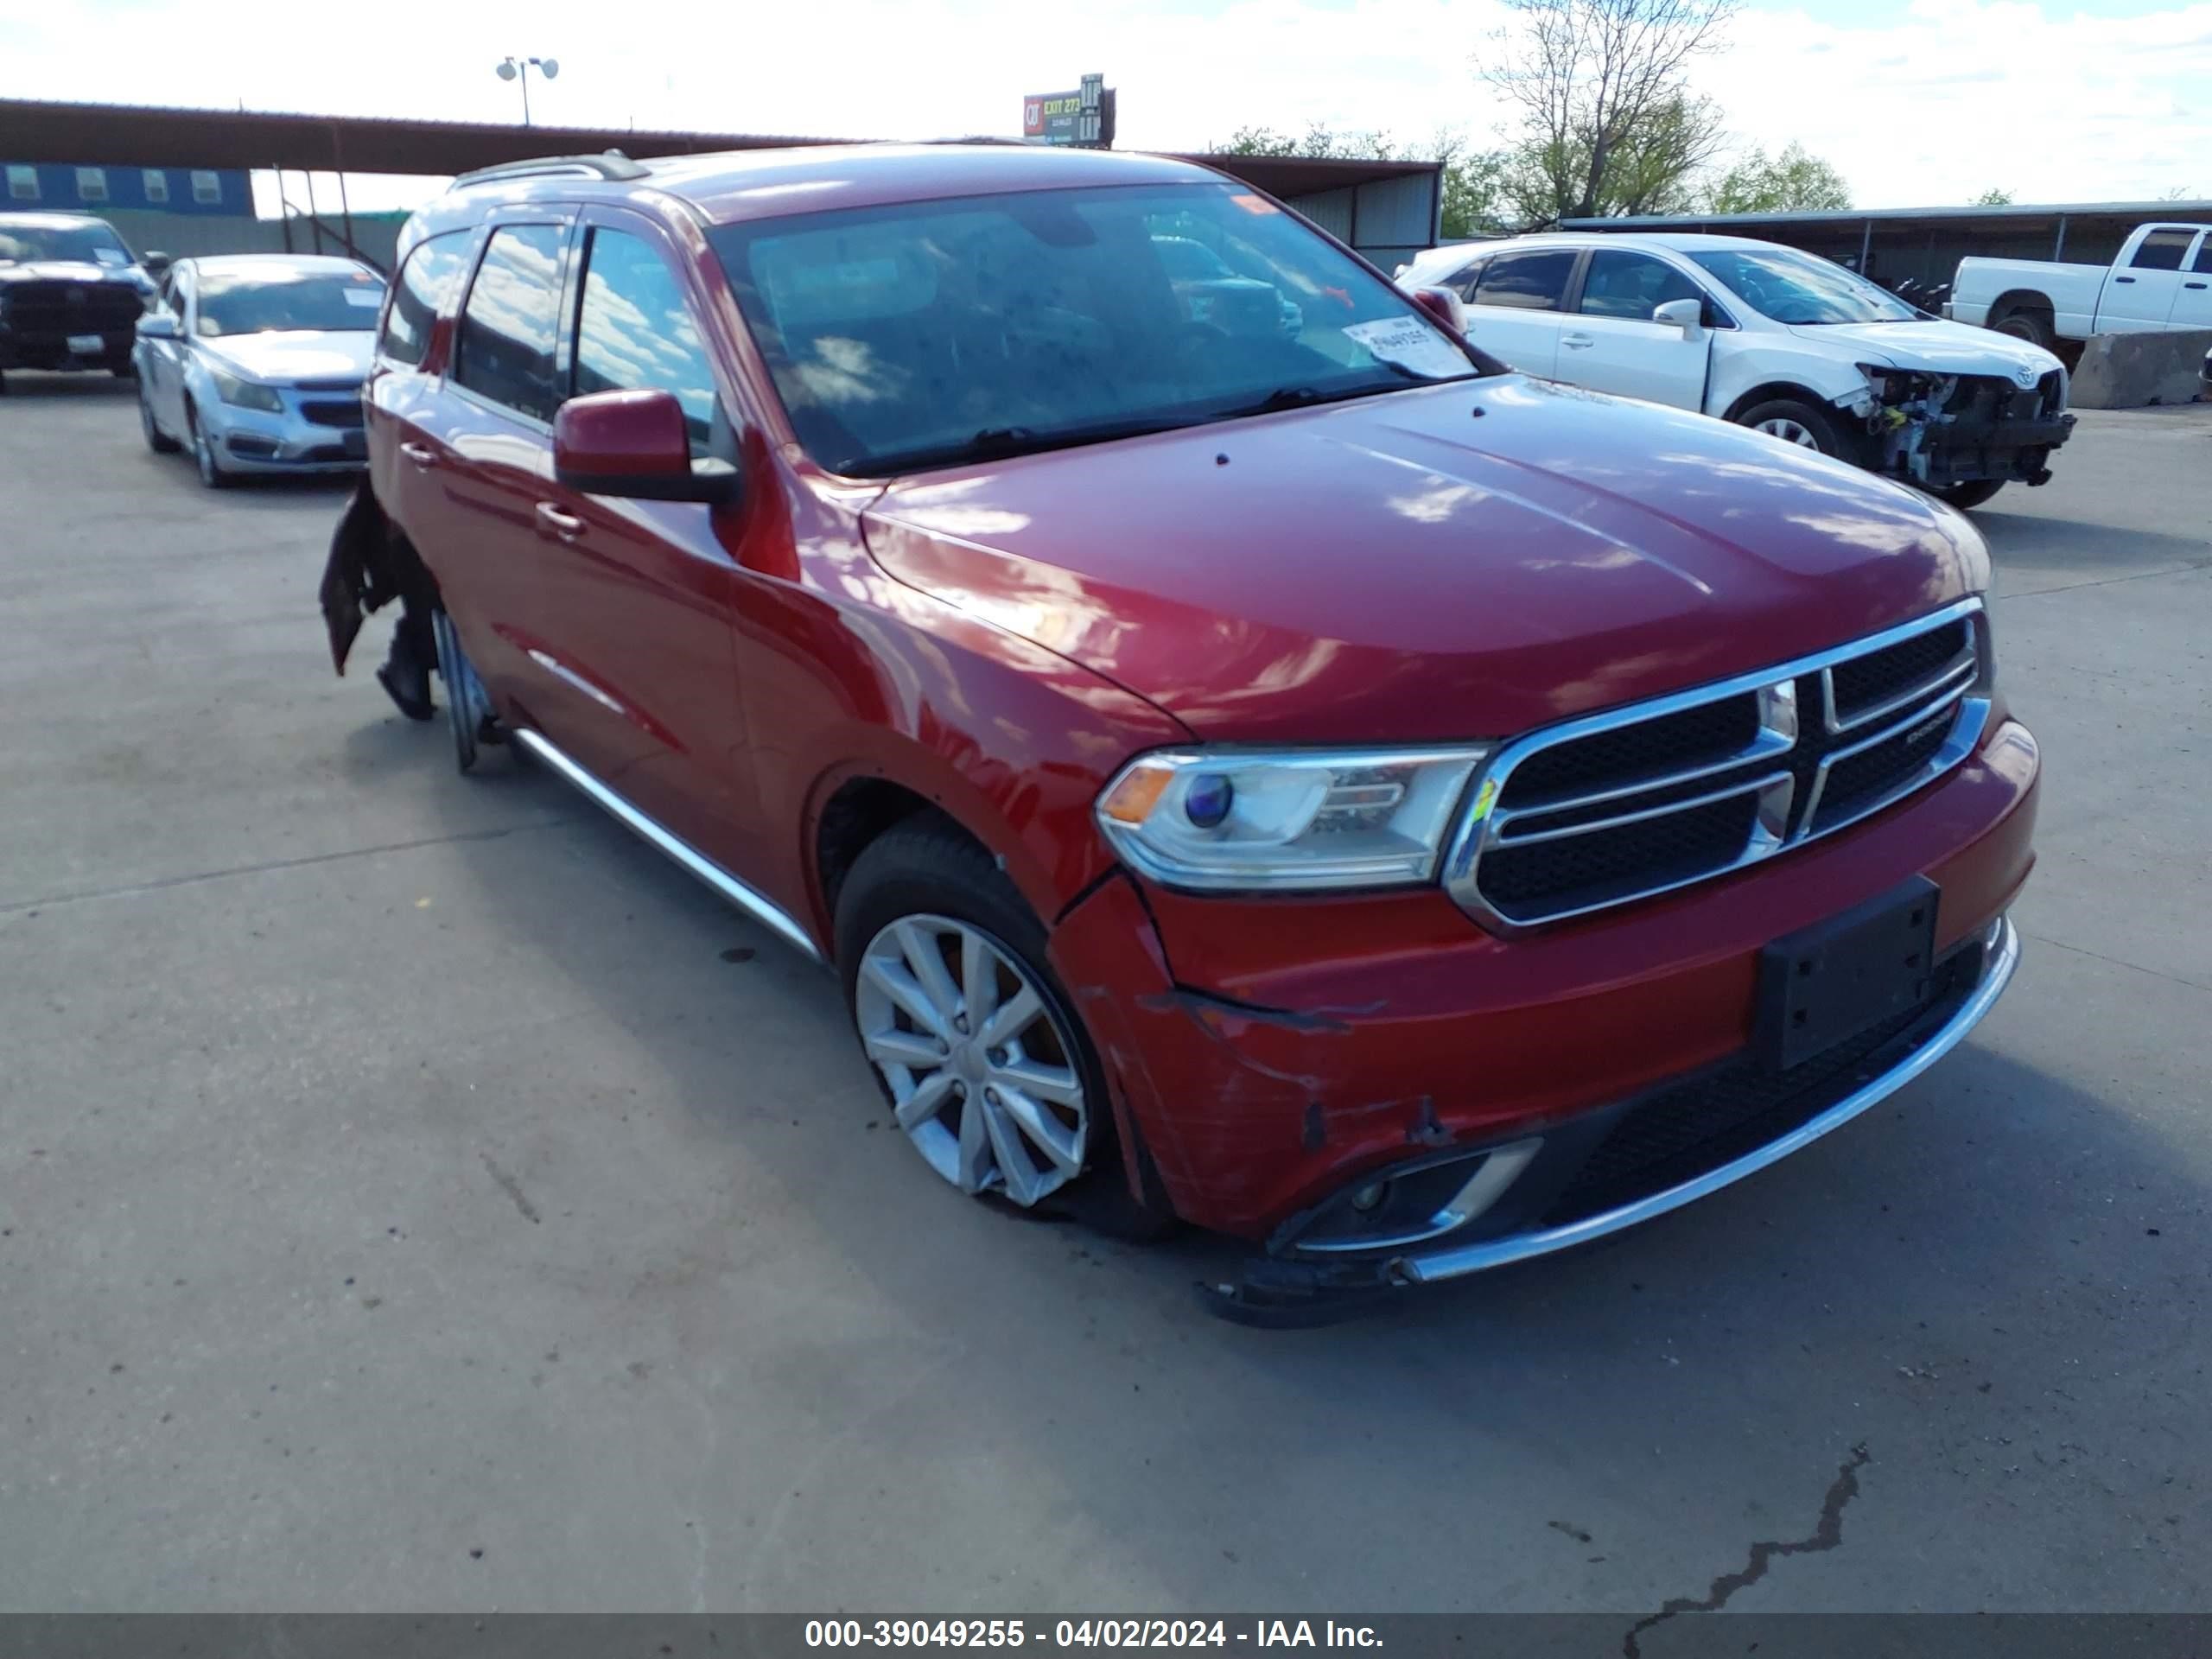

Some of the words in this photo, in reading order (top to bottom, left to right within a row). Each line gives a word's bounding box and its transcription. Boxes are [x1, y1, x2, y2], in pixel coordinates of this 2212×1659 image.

[1026, 104, 1039, 126] QT
[1044, 99, 1063, 115] EXIT
[1065, 98, 1080, 113] 273
